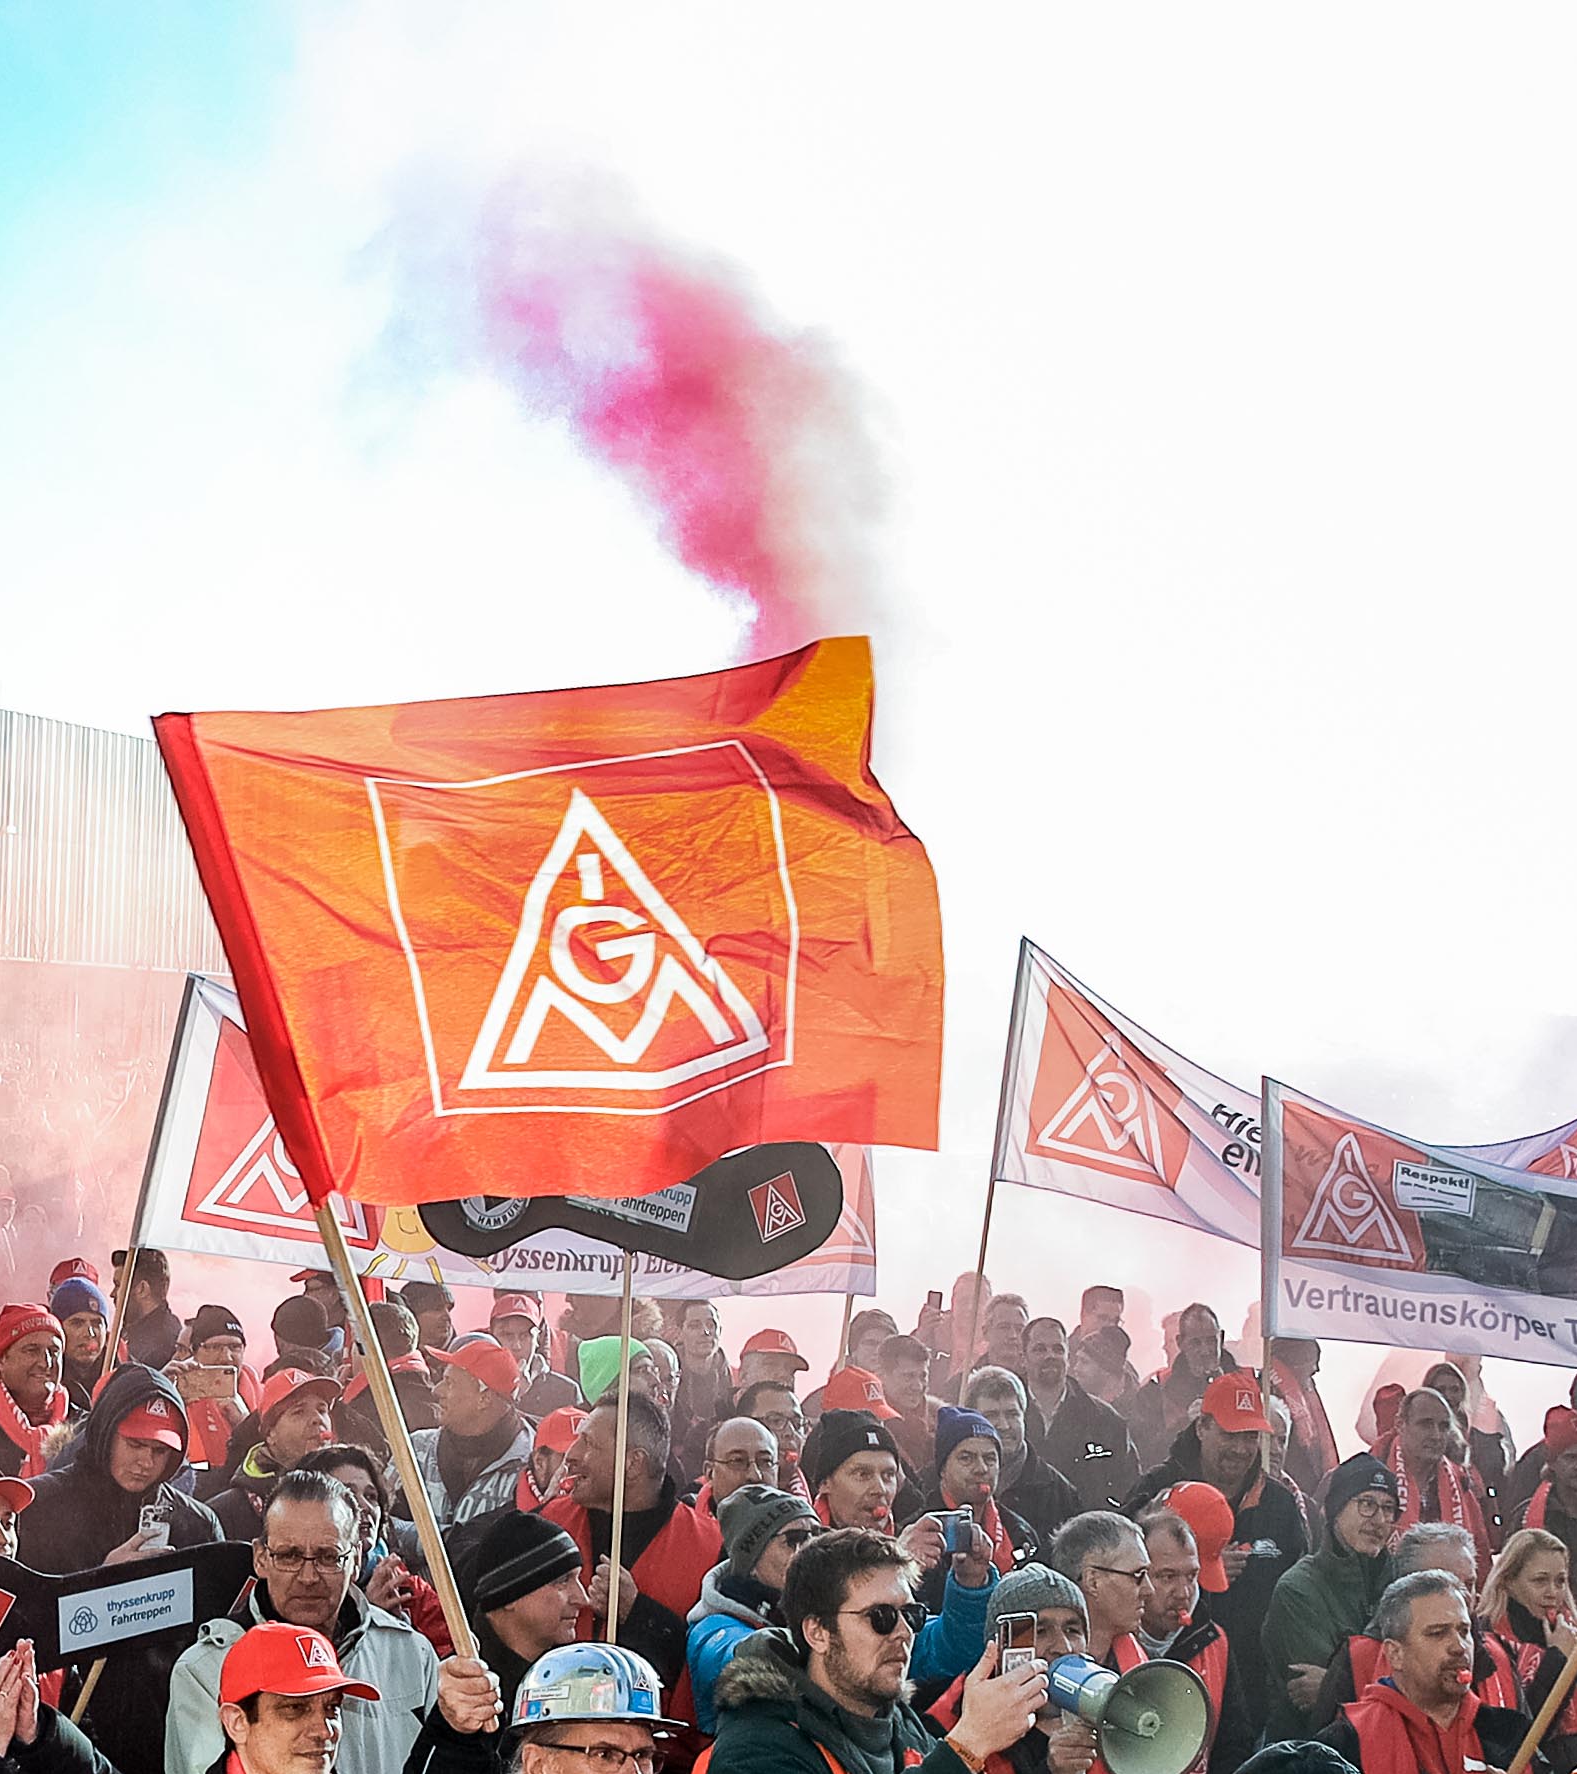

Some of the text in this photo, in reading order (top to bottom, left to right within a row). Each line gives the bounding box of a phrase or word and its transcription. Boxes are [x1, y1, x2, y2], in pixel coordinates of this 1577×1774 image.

[1400, 1165, 1470, 1190] Respekt!
[1283, 1277, 1558, 1342] Vertrauenskörper
[106, 1586, 176, 1612] thyssenkrupp
[110, 1603, 172, 1627] Fahrtreppen
